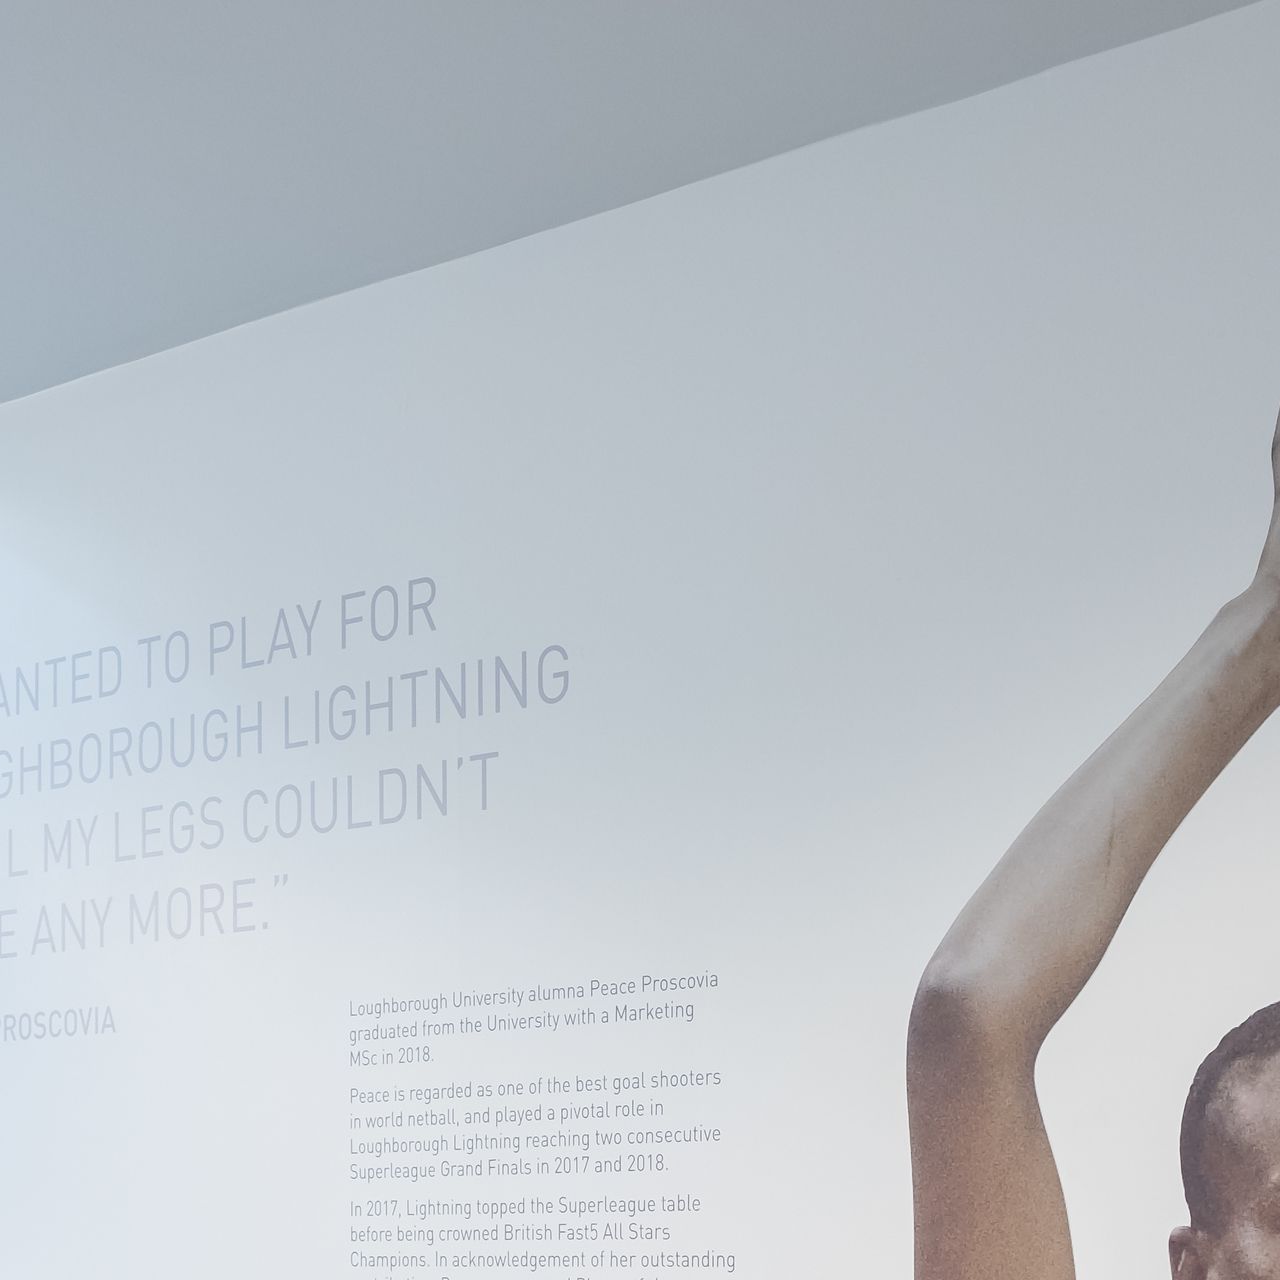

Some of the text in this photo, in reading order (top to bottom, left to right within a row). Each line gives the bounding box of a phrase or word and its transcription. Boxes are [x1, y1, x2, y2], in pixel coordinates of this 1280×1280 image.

[137, 630, 190, 689] TO
[209, 599, 323, 676] PLAY
[340, 576, 437, 650] FOR
[284, 644, 570, 750] LIGHTNING
[43, 814, 99, 873] MY
[114, 795, 225, 863] LEGS
[30, 895, 113, 956] ANY
[349, 970, 718, 1020] Loughborough University alumna Peace Proscovia
[349, 1001, 694, 1047] graduated from the University with a Marketing
[349, 1045, 435, 1067] MSc in 2018.
[350, 1069, 722, 1105] Peace is regarded as one of the best goal shooters
[350, 1098, 664, 1130] in world netball, and played a pivotal role in
[350, 1126, 721, 1159] Loughborough Lightning reaching two consecutive
[349, 1153, 669, 1184] Superleague Grand Finals in 2017 and 2018.
[350, 1193, 701, 1221] In 2017, Lightning topped the Superleague table
[350, 1221, 671, 1247] before being crowned British Fast5 All Stars
[435, 1250, 448, 1268] In
[451, 1249, 586, 1273] acknowledgement
[590, 1249, 606, 1268] of
[609, 1249, 637, 1268] her
[640, 1249, 736, 1274] outstanding
